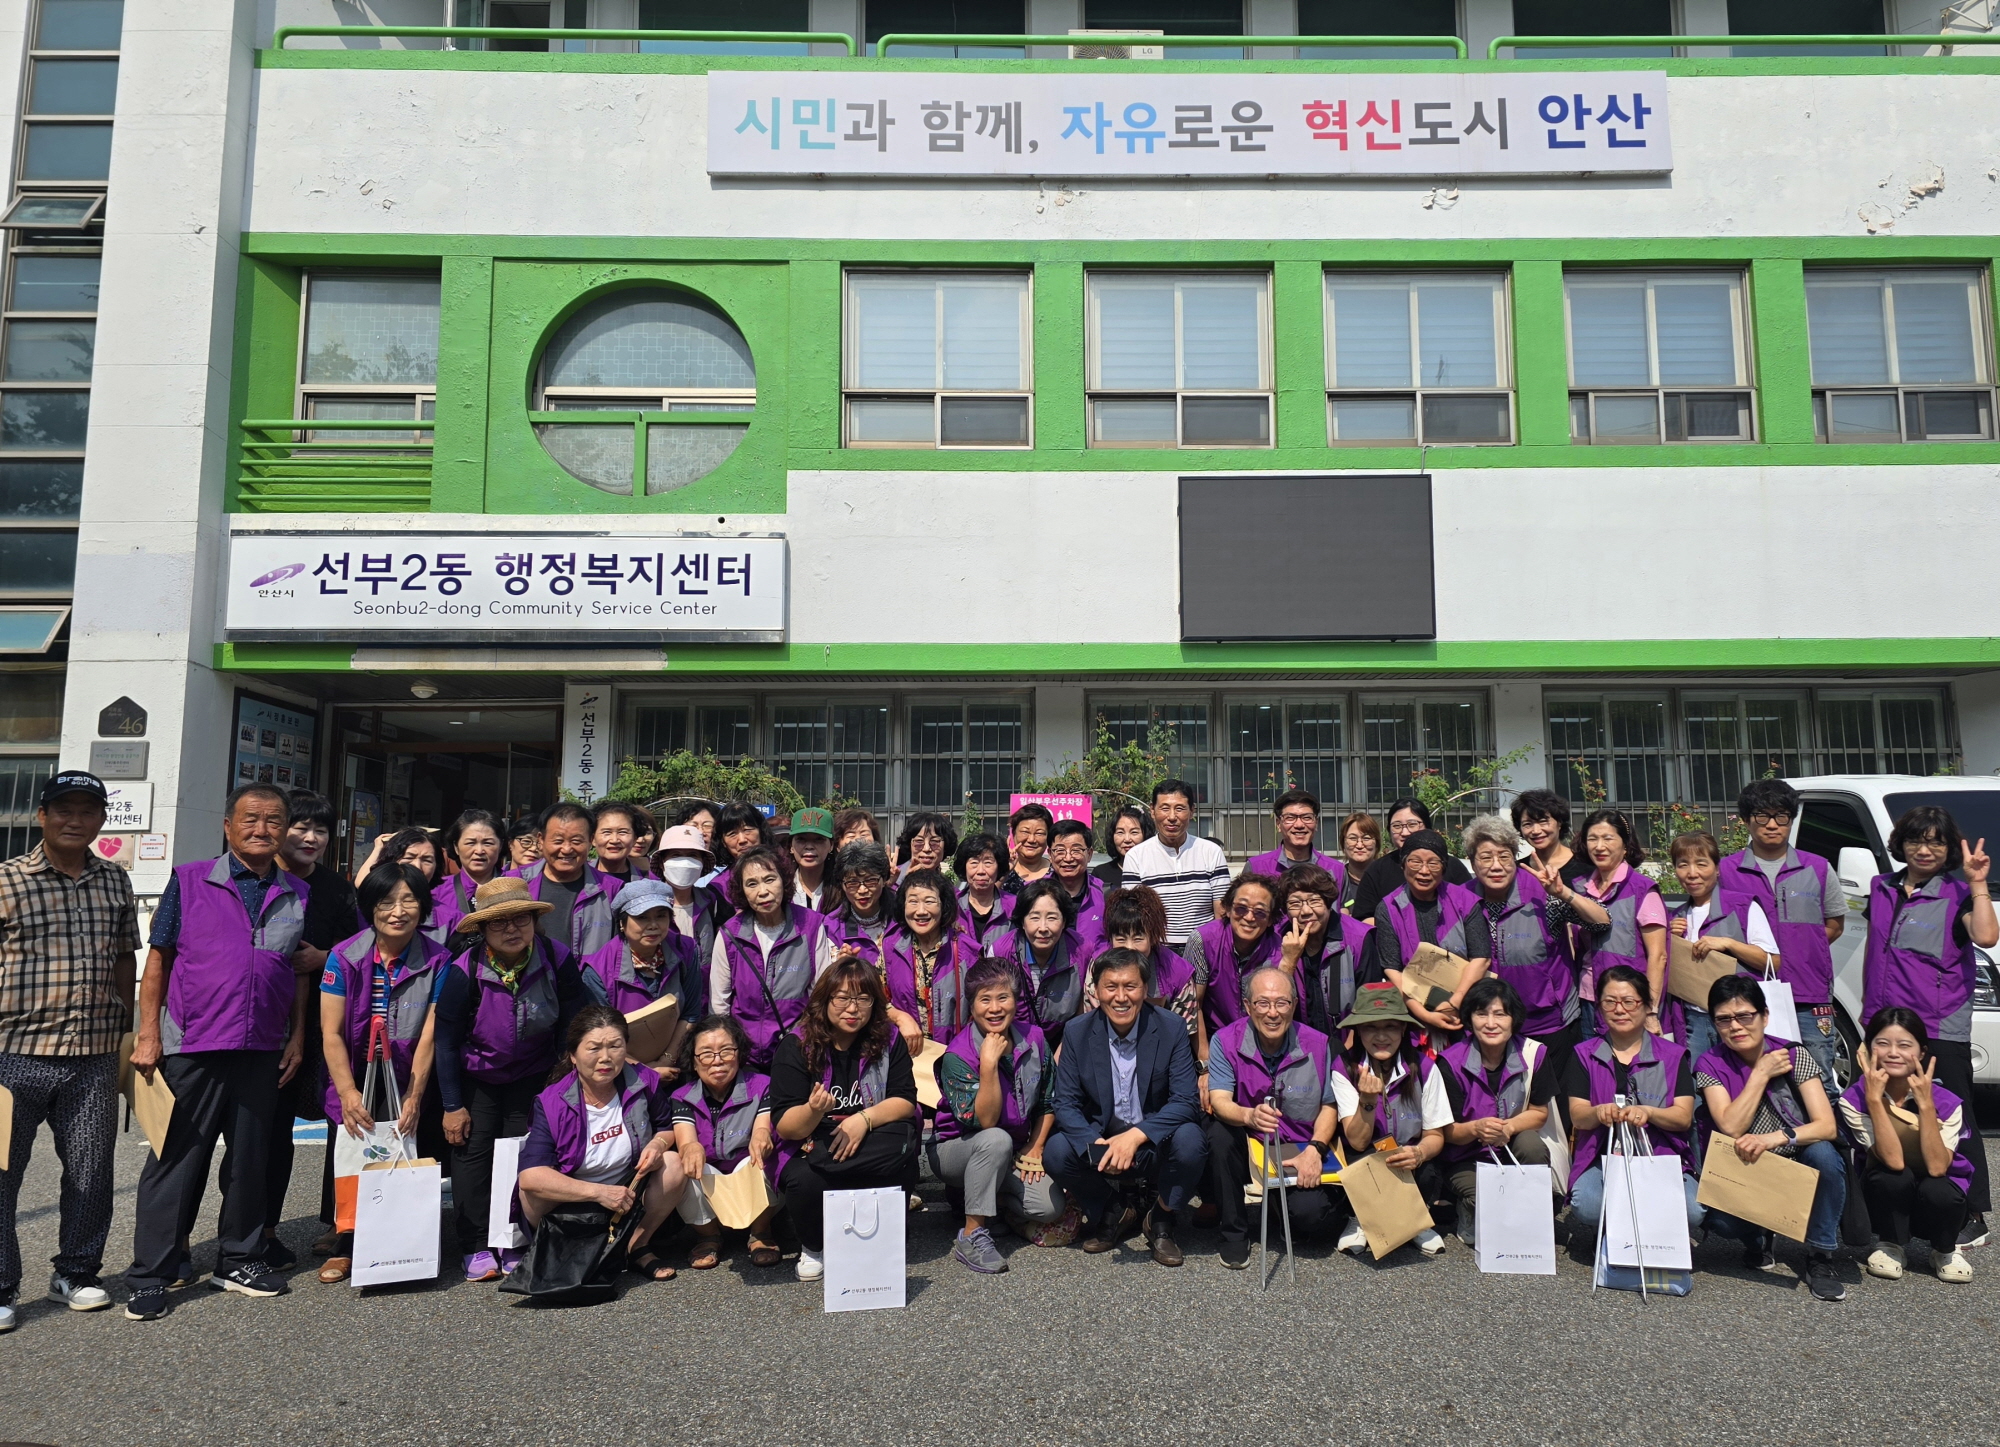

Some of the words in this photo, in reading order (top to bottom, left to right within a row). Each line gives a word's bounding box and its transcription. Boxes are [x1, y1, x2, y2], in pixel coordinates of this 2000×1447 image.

[734, 97, 896, 153] 시민과
[920, 100, 1039, 155] 함께,
[1060, 100, 1274, 155] 자유로운
[1302, 97, 1509, 152] 혁신도시
[1537, 92, 1652, 150] 안산
[311, 551, 473, 597] 선부2동
[494, 552, 752, 597] 행정복지센터
[258, 590, 294, 598] 안산시
[353, 600, 481, 618] Seonbu2-dong
[488, 600, 584, 618] Community
[591, 600, 653, 616] Service
[659, 600, 718, 616] Center
[118, 717, 143, 733] 46
[578, 712, 595, 774] 선부2동
[1019, 796, 1083, 806] 임산부우선주차장
[801, 810, 823, 827] NY
